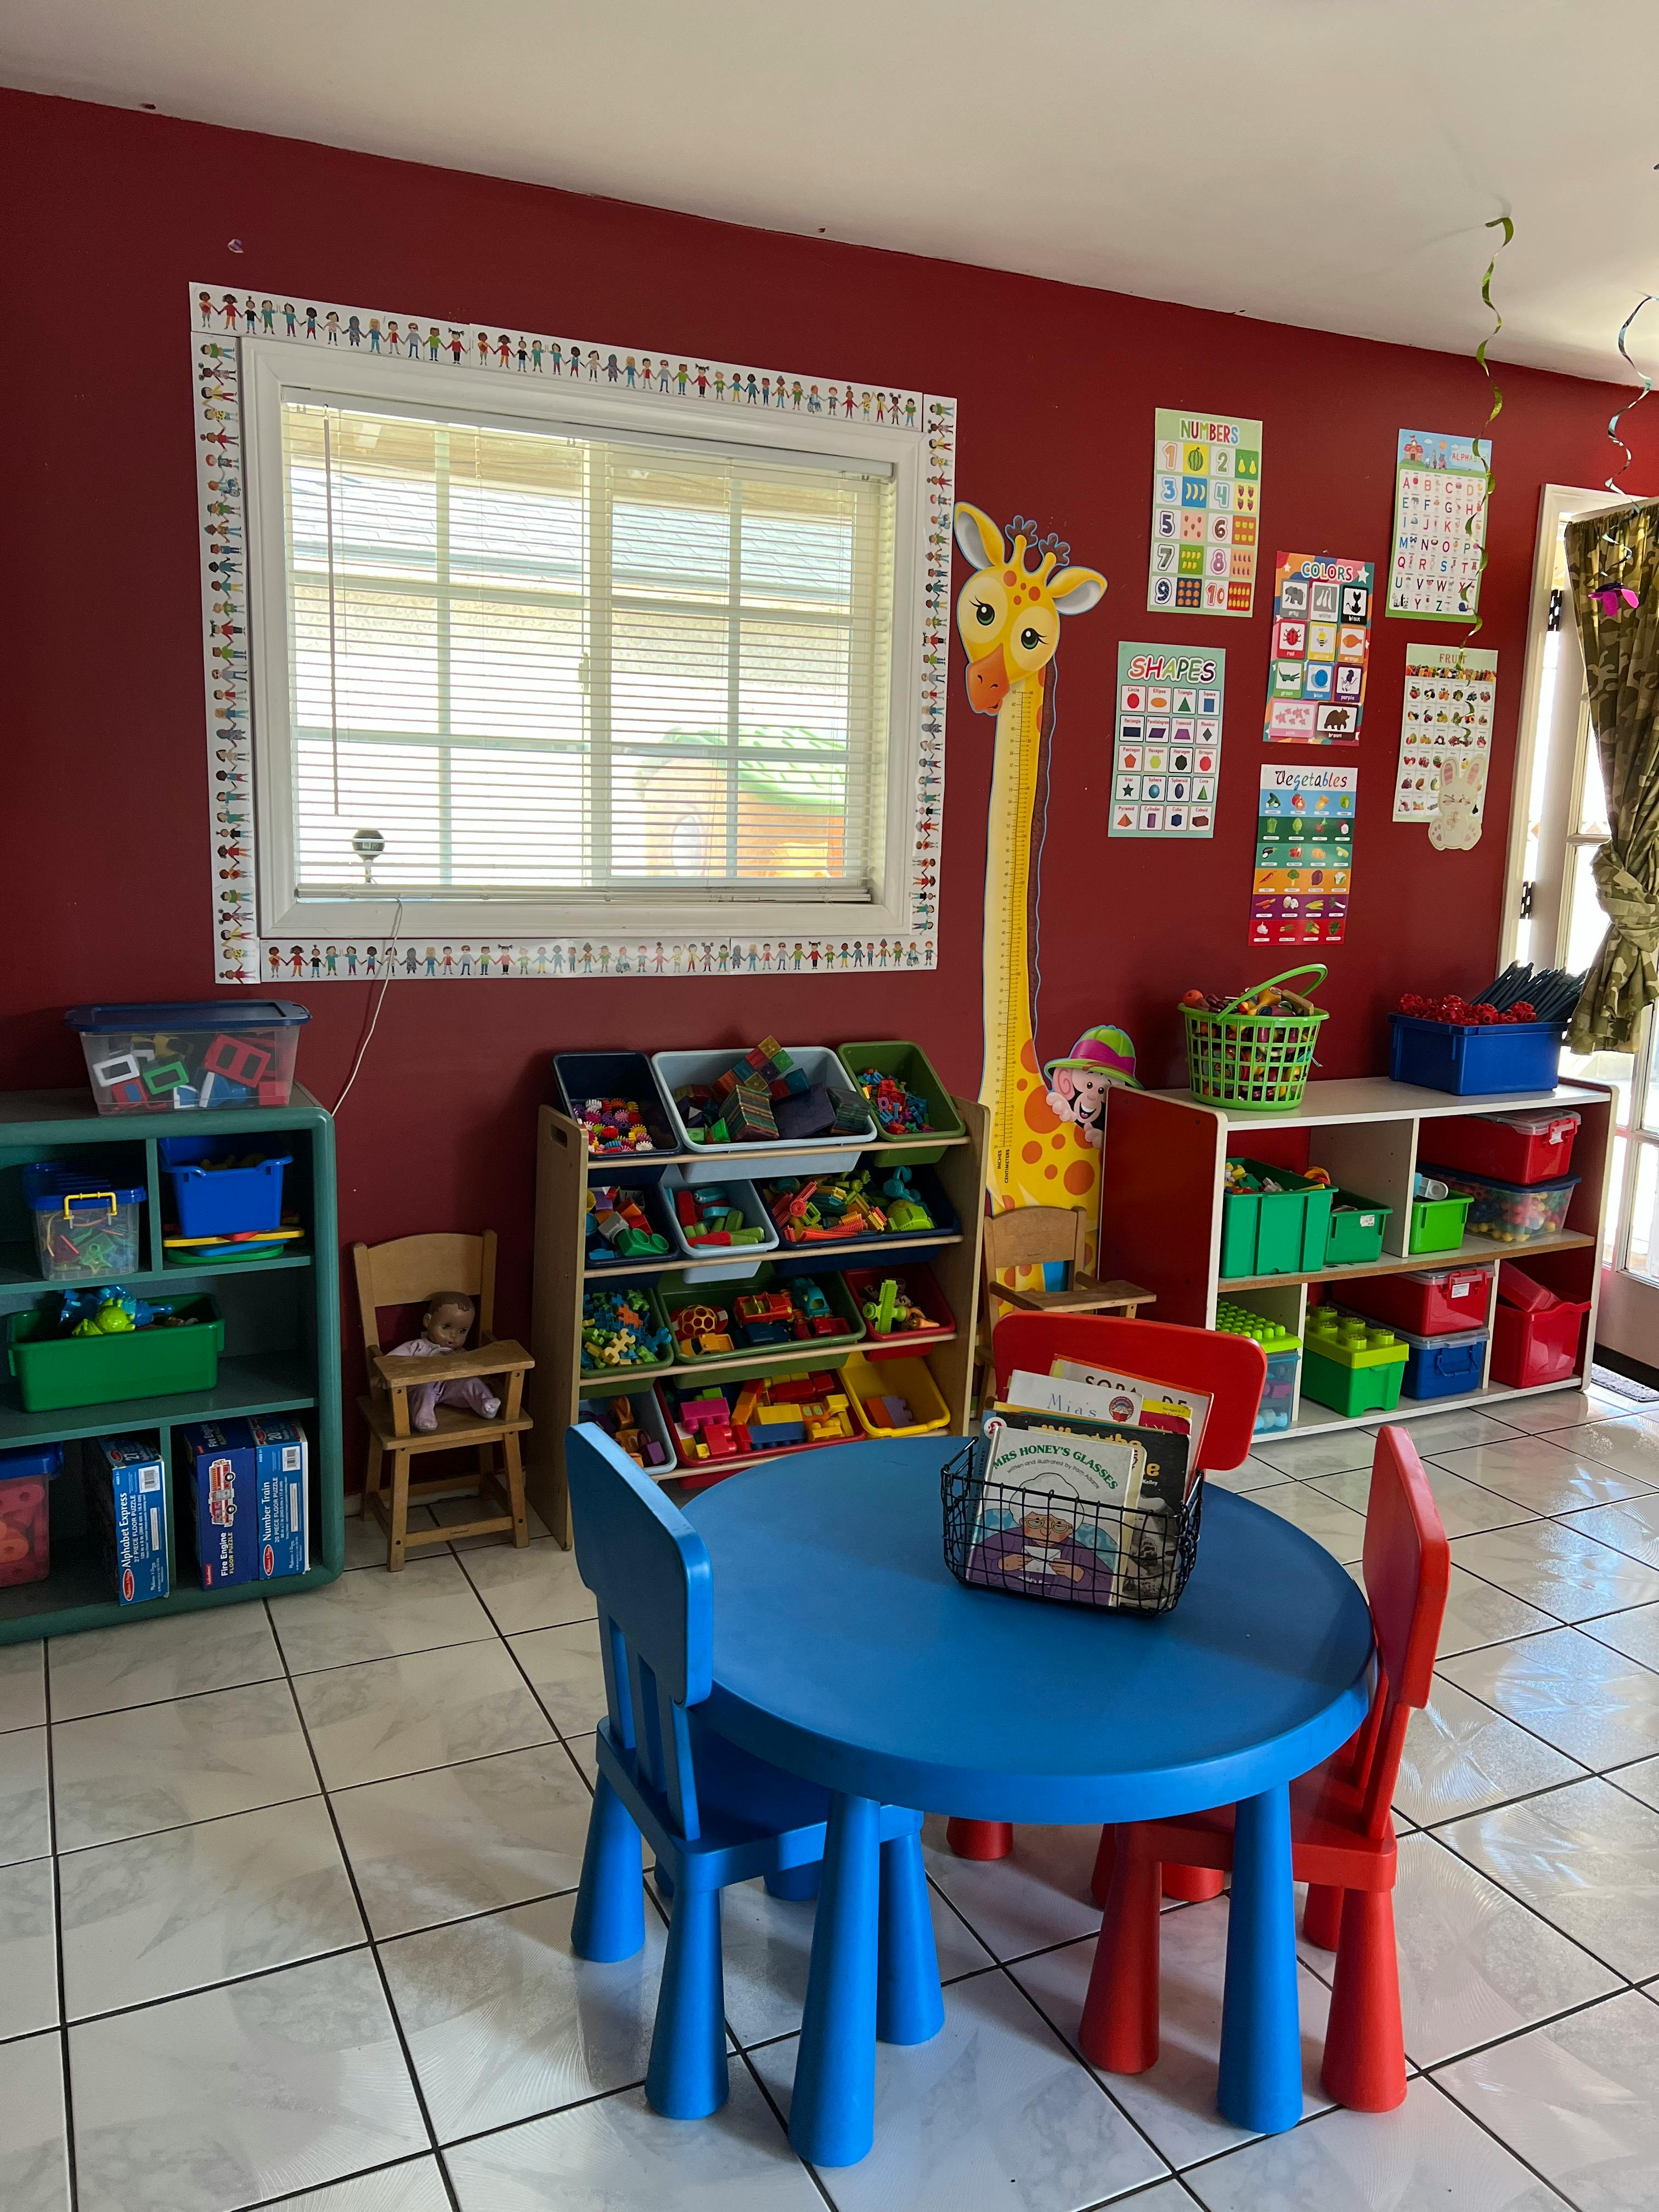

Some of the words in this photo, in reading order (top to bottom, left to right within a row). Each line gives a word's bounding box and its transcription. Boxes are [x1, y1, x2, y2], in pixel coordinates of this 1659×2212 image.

[1181, 420, 1238, 444] NUMBERS
[1164, 443, 1177, 470] 1
[1217, 450, 1229, 473] 2
[1162, 478, 1177, 501] 3
[1215, 483, 1229, 507] 4
[1403, 477, 1410, 489] A
[1425, 480, 1431, 491] B
[1446, 482, 1453, 493] C
[1467, 484, 1474, 495] D
[1403, 497, 1409, 508] E
[1424, 500, 1431, 510] F
[1445, 502, 1452, 513] G
[1466, 504, 1472, 515] H
[1160, 511, 1174, 536] 5
[1214, 517, 1228, 540] 6
[1423, 519, 1429, 530] J
[1444, 521, 1451, 532] K
[1400, 537, 1408, 549] M
[1421, 539, 1429, 550] N
[1443, 541, 1449, 552] O
[1464, 543, 1470, 554] P
[1158, 545, 1175, 570] 7
[1211, 550, 1226, 574] 8
[1302, 562, 1352, 581] COLORS
[1398, 557, 1405, 568] Q
[1419, 558, 1426, 570] R
[1441, 561, 1447, 572] S
[1462, 562, 1468, 573] T
[1155, 578, 1171, 604] 9
[1206, 583, 1224, 605] 10
[1396, 577, 1402, 588] U
[1417, 578, 1424, 590] V
[1437, 580, 1447, 591] W
[1415, 599, 1421, 610] Y
[1436, 600, 1442, 611] Z
[1129, 657, 1215, 682] SHAPES
[1439, 653, 1467, 664] FRUT
[1276, 770, 1347, 791] Vegetables
[1047, 1393, 1097, 1418] Mia's
[993, 1451, 1017, 1469] MRS
[1020, 1445, 1071, 1457] HONEY'S
[1073, 1452, 1118, 1489] GLASSES
[1007, 1463, 1024, 1474] written
[1073, 1466, 1085, 1475] Pam
[1085, 1474, 1099, 1489] Adams
[261, 1482, 270, 1504] Train
[119, 1493, 130, 1526] Express
[261, 1505, 272, 1541] Number
[120, 1528, 133, 1567] Alphabet
[219, 1532, 228, 1559] Engine
